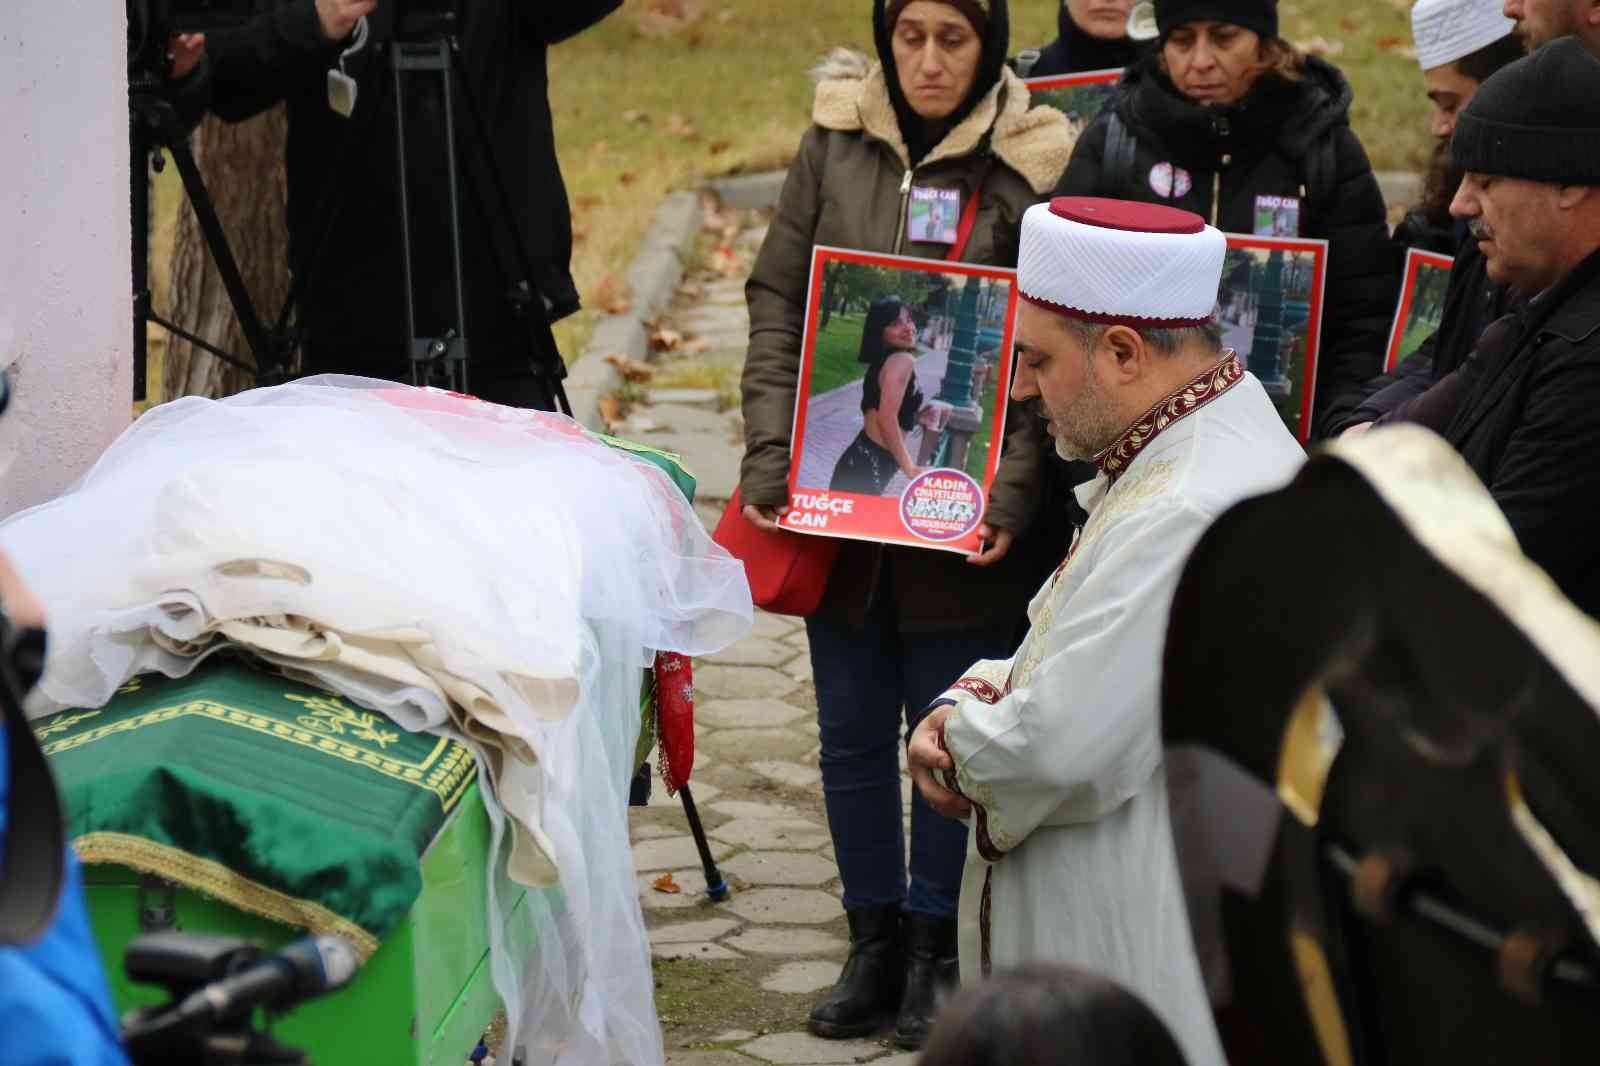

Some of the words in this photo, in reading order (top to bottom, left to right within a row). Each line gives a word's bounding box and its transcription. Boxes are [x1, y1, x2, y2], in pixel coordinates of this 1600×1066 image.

[923, 477, 969, 491] KADIN
[791, 493, 855, 517] TUĞÇE
[787, 511, 829, 528] CAN
